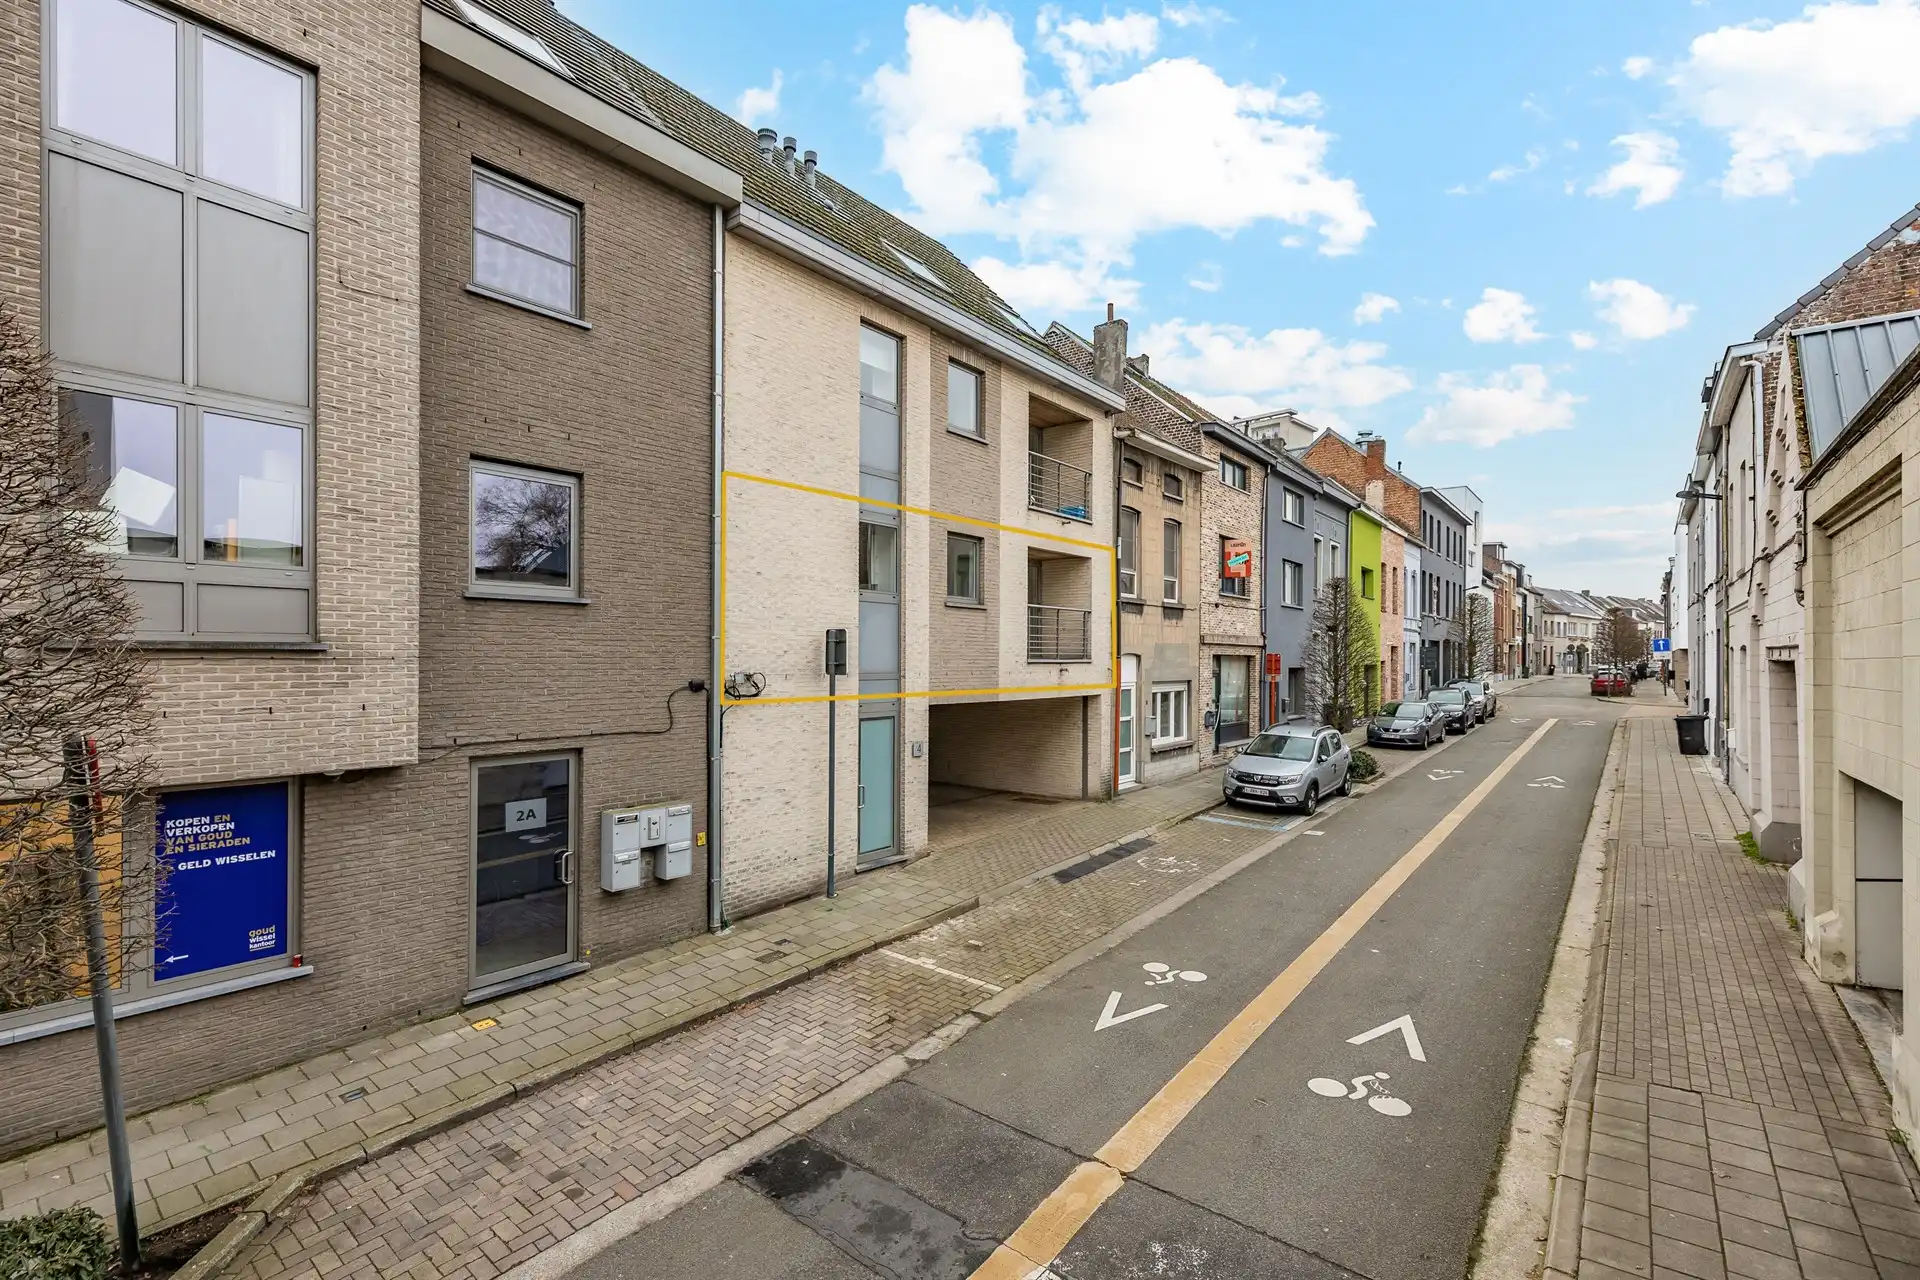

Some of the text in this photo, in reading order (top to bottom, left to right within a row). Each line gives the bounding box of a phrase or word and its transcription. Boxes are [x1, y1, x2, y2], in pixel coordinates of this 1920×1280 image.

[166, 814, 231, 828] KOPEN EN
[516, 809, 537, 822] 2A
[166, 822, 235, 837] VERKOPEN
[167, 830, 233, 846] VAN GOUD
[166, 837, 251, 855] EN SIERADEN
[178, 850, 276, 871] GELD WISSELEN
[249, 925, 276, 938] goud
[249, 933, 276, 943] wissel
[249, 940, 276, 949] kantoor
